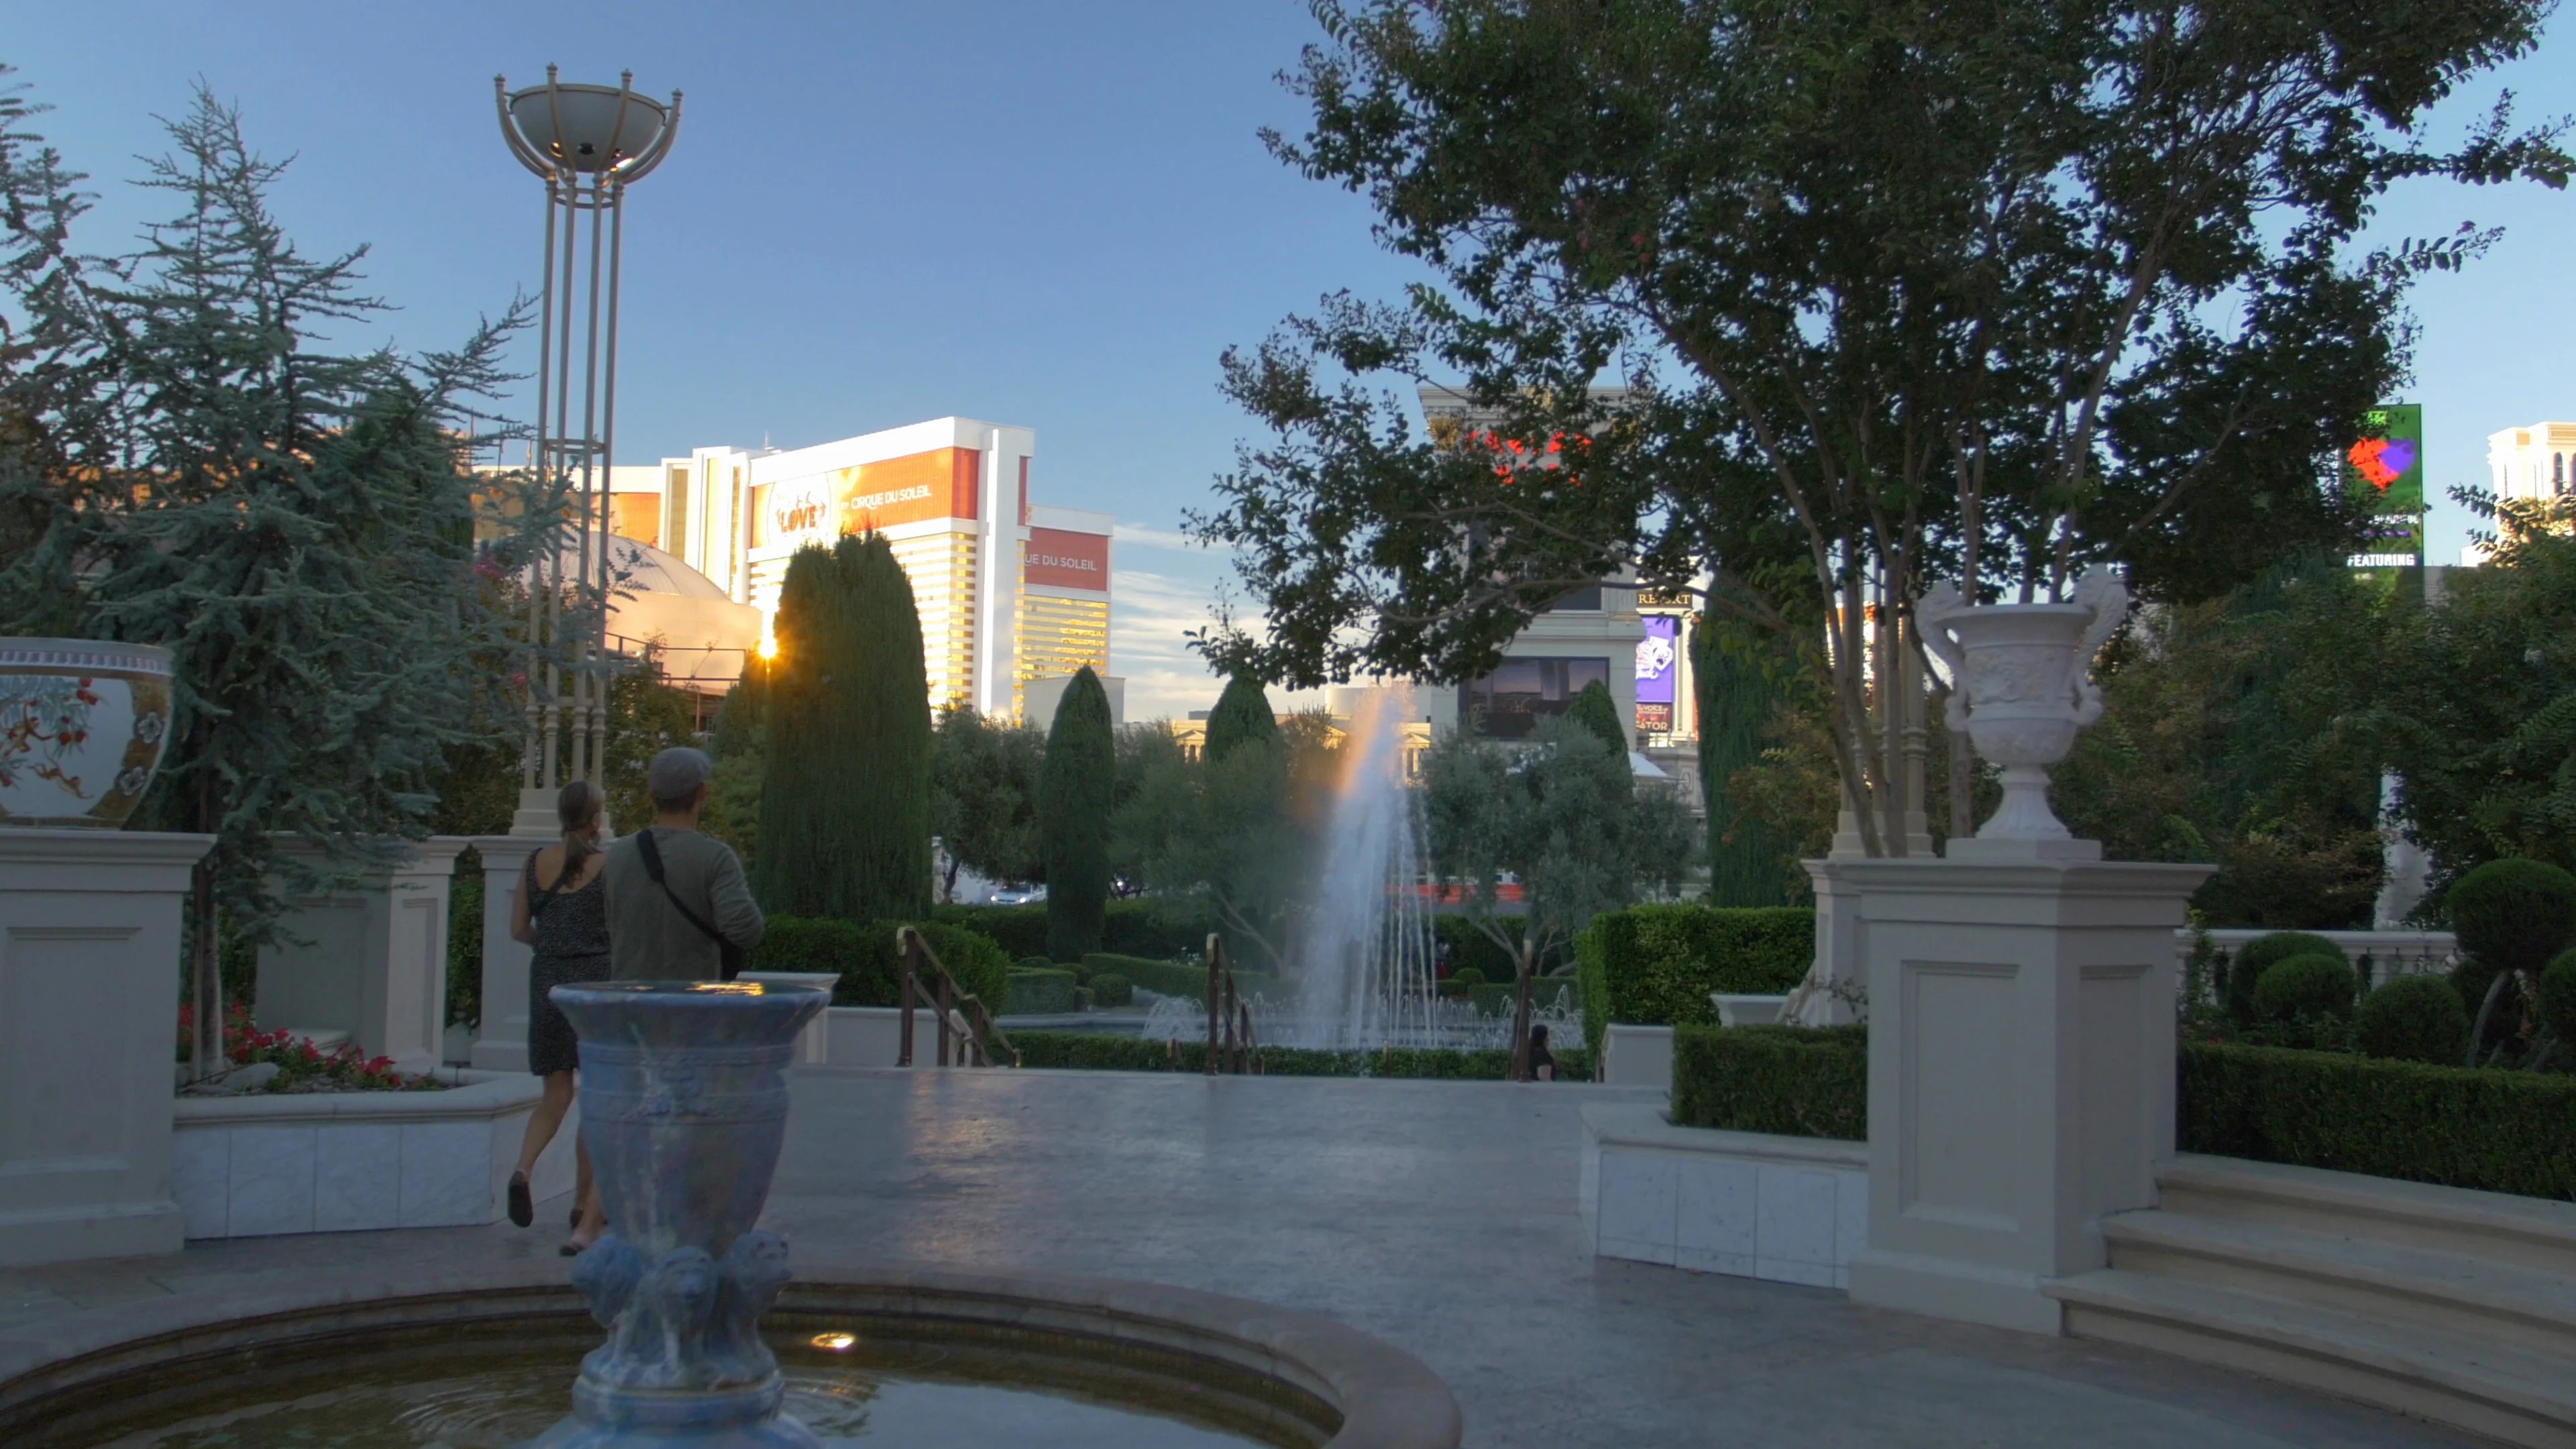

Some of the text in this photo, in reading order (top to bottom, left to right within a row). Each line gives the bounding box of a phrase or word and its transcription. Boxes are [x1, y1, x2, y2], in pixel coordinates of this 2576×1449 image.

[851, 493, 884, 510] CIRQUE
[885, 490, 898, 504] DU
[900, 484, 932, 502] SOLEIL
[780, 505, 817, 533] LOVE
[1024, 553, 1097, 571] UE DU SOLEIL
[2347, 553, 2415, 567] FEATURING
[1638, 594, 1690, 604] REORT
